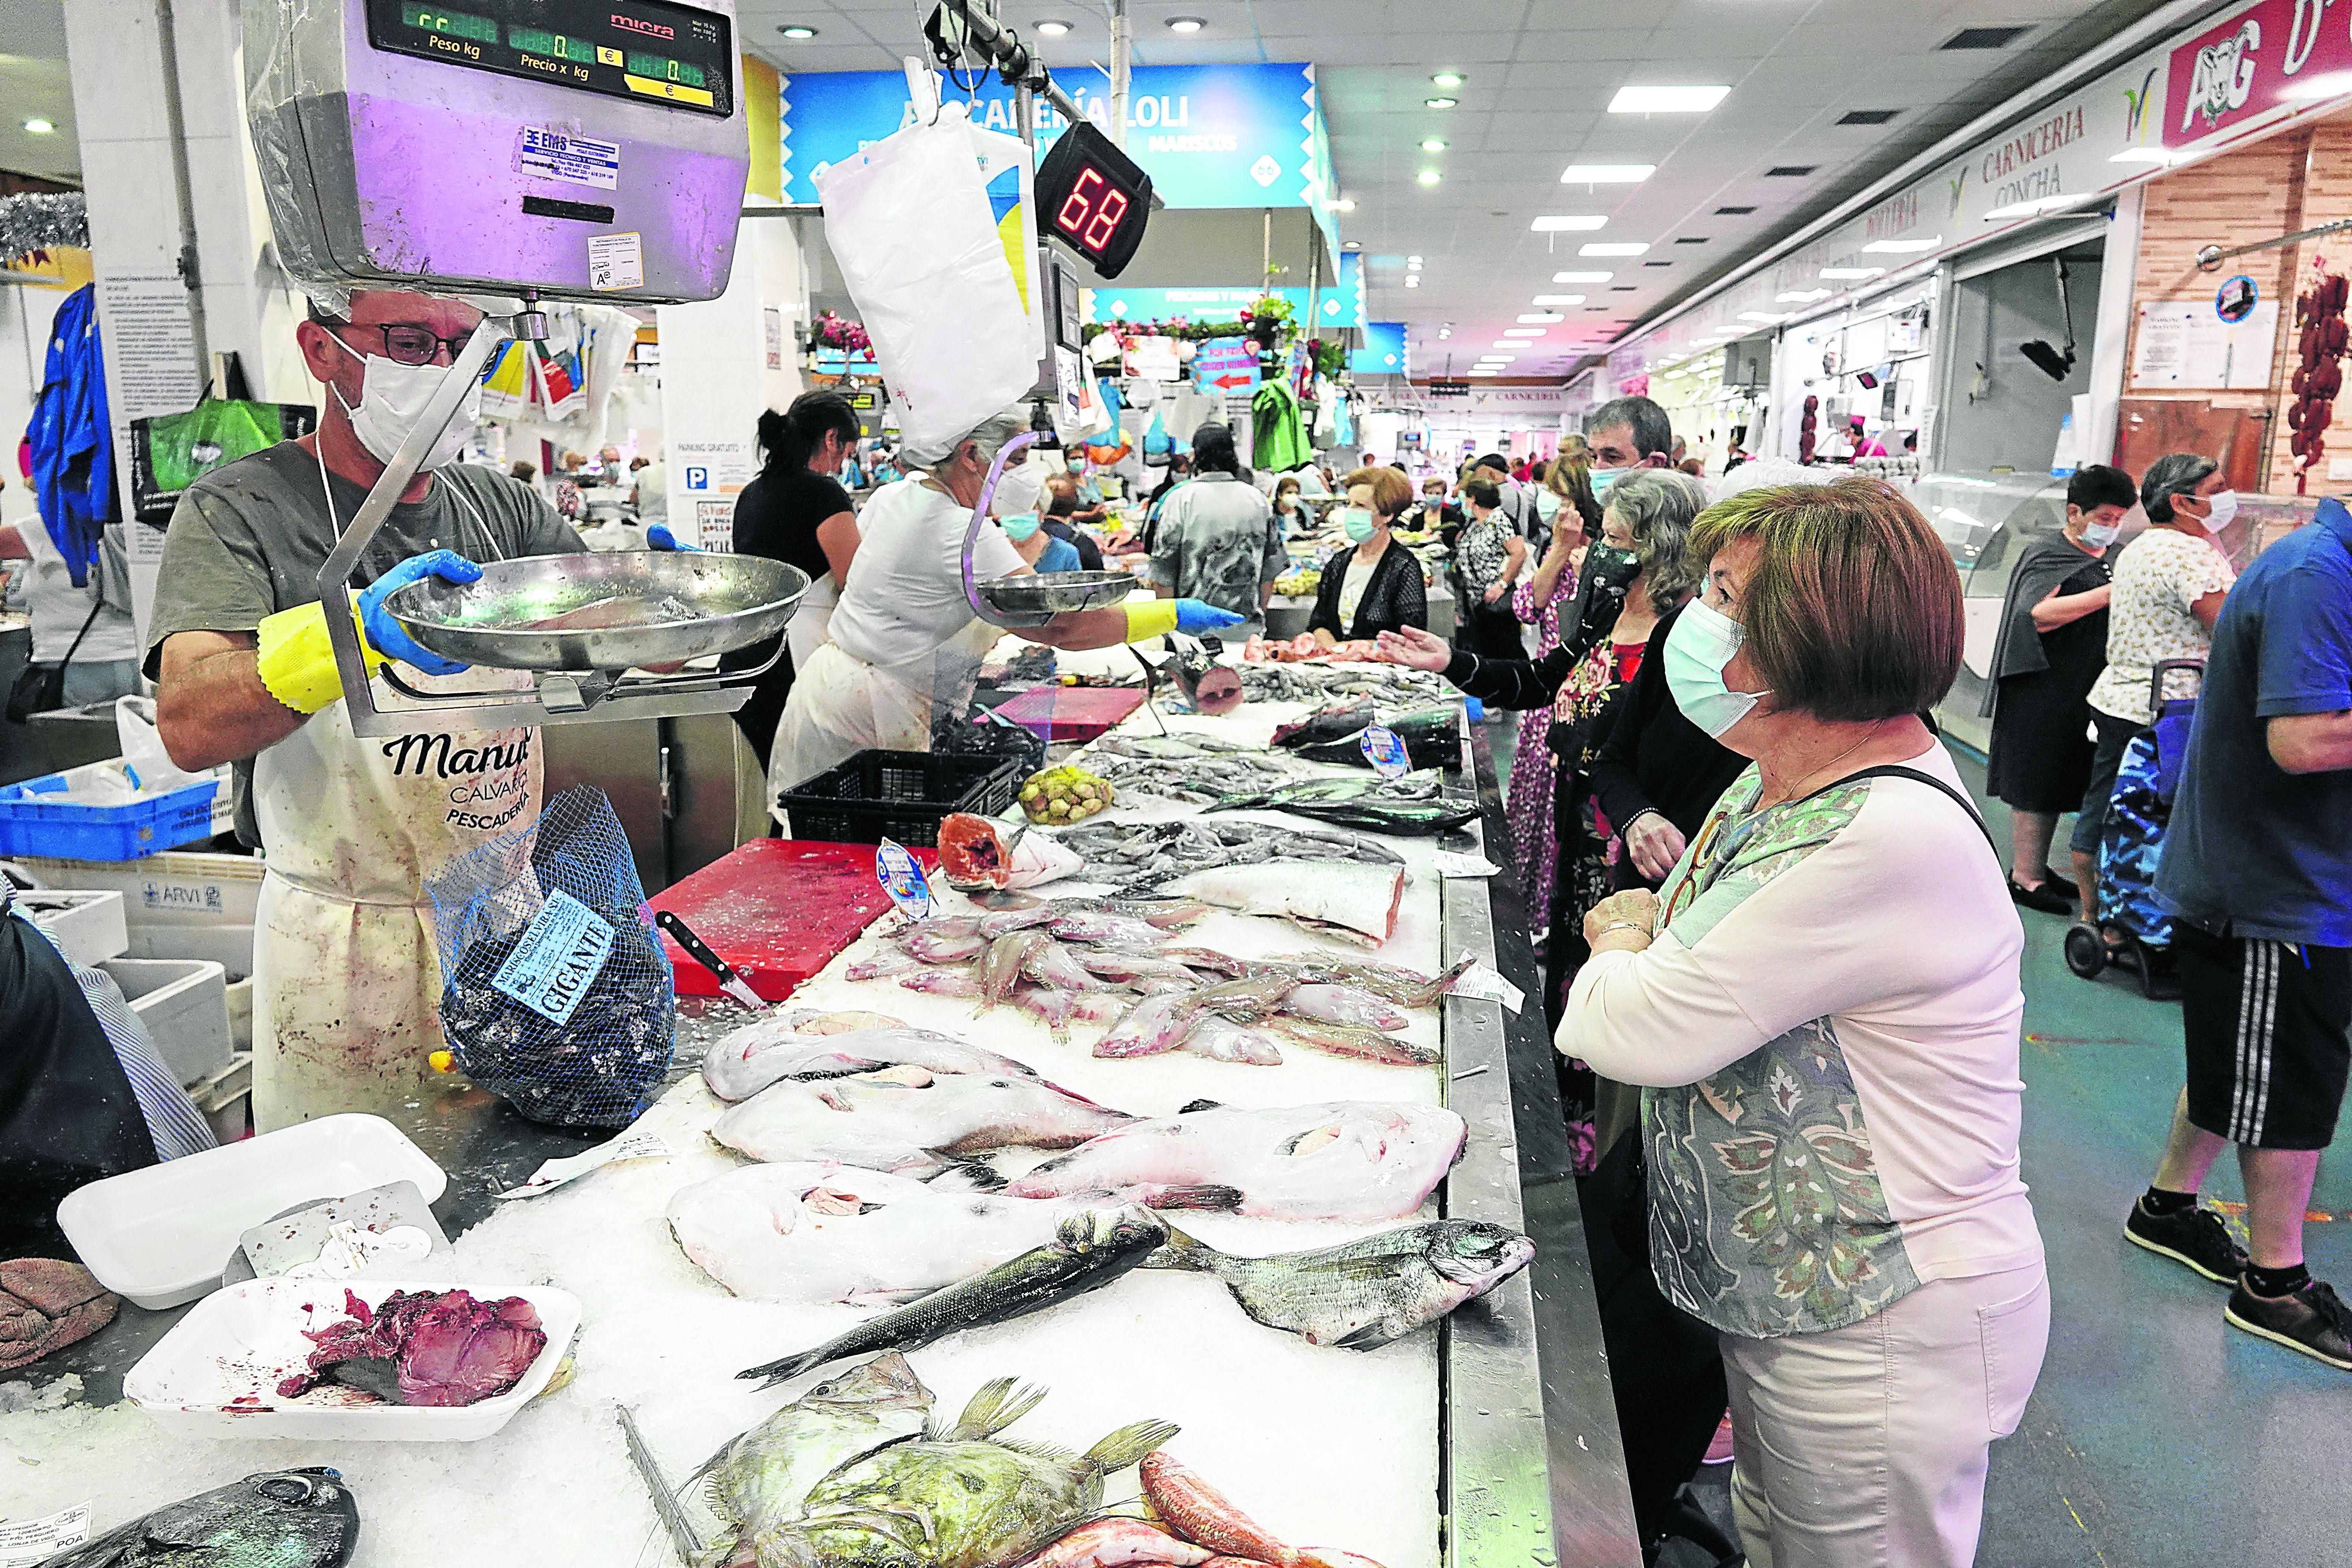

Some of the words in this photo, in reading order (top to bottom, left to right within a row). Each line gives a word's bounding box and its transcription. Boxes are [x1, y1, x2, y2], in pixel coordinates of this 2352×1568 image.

[610, 14, 674, 37] micra
[429, 35, 460, 52] Peso
[464, 42, 481, 59] kg
[521, 54, 557, 71] Precio
[560, 66, 567, 74] x
[574, 65, 589, 81] kg
[535, 148, 558, 157] SERVICIO
[542, 132, 567, 151] EMS
[1148, 134, 1238, 153] MARISCOS
[1982, 105, 2085, 184] CARNICERIA
[1994, 162, 2062, 209] CONCHA
[1059, 168, 1128, 250] 68
[163, 885, 200, 903] ARVI
[497, 940, 532, 985] MARISCOS
[527, 911, 553, 942] ELVIRA
[541, 922, 608, 1013] GIGANTE
[25, 1528, 60, 1539] PESQUERO
[56, 1534, 83, 1549] POA
